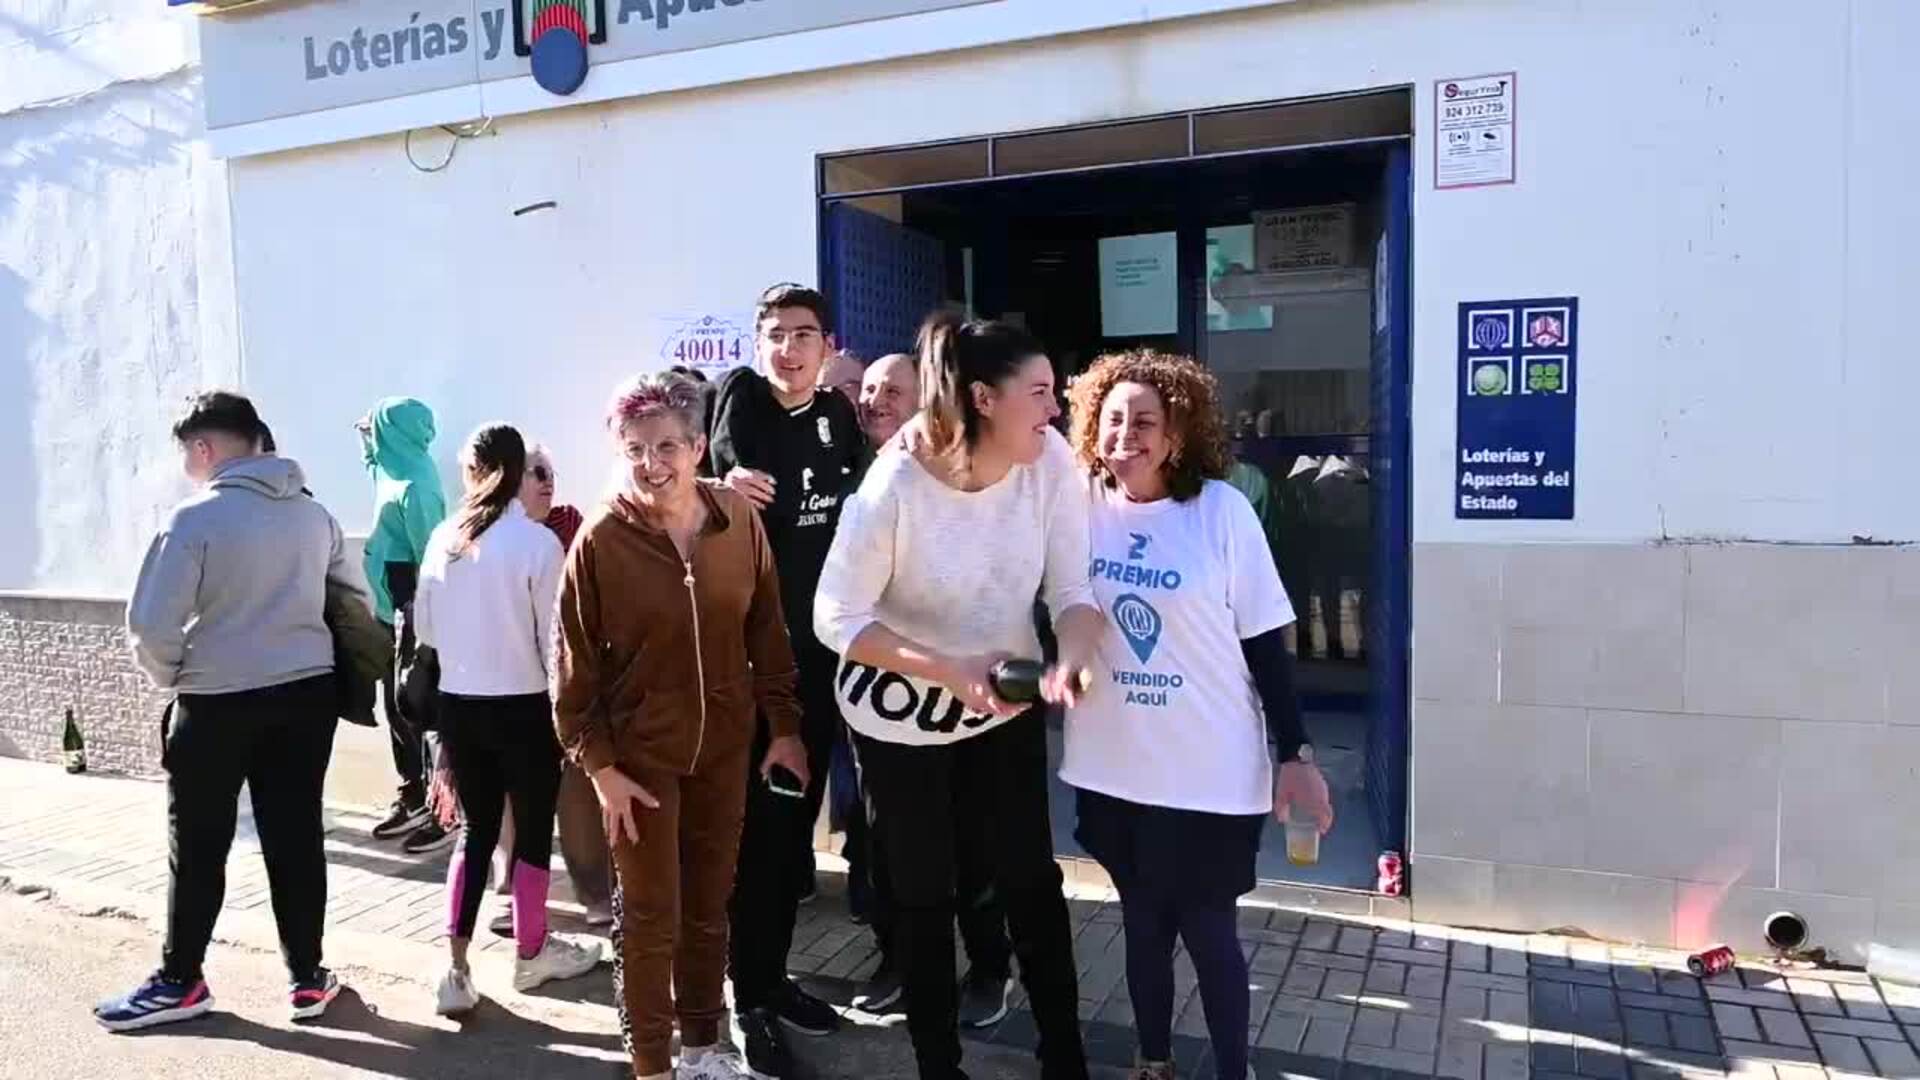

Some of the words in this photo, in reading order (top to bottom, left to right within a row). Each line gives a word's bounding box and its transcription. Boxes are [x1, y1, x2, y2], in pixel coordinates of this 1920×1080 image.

[303, 11, 468, 80] Loterías
[480, 8, 505, 60] y
[674, 338, 741, 362] 40014
[1462, 448, 1529, 463] Loterías
[1534, 451, 1545, 466] y
[1461, 472, 1538, 490] Apuestas
[1542, 471, 1569, 487] del
[1460, 495, 1518, 510] Estado
[1092, 558, 1181, 591] PREMIO
[1112, 669, 1184, 688] VENDIDO
[1125, 690, 1167, 706] AQUÍ
